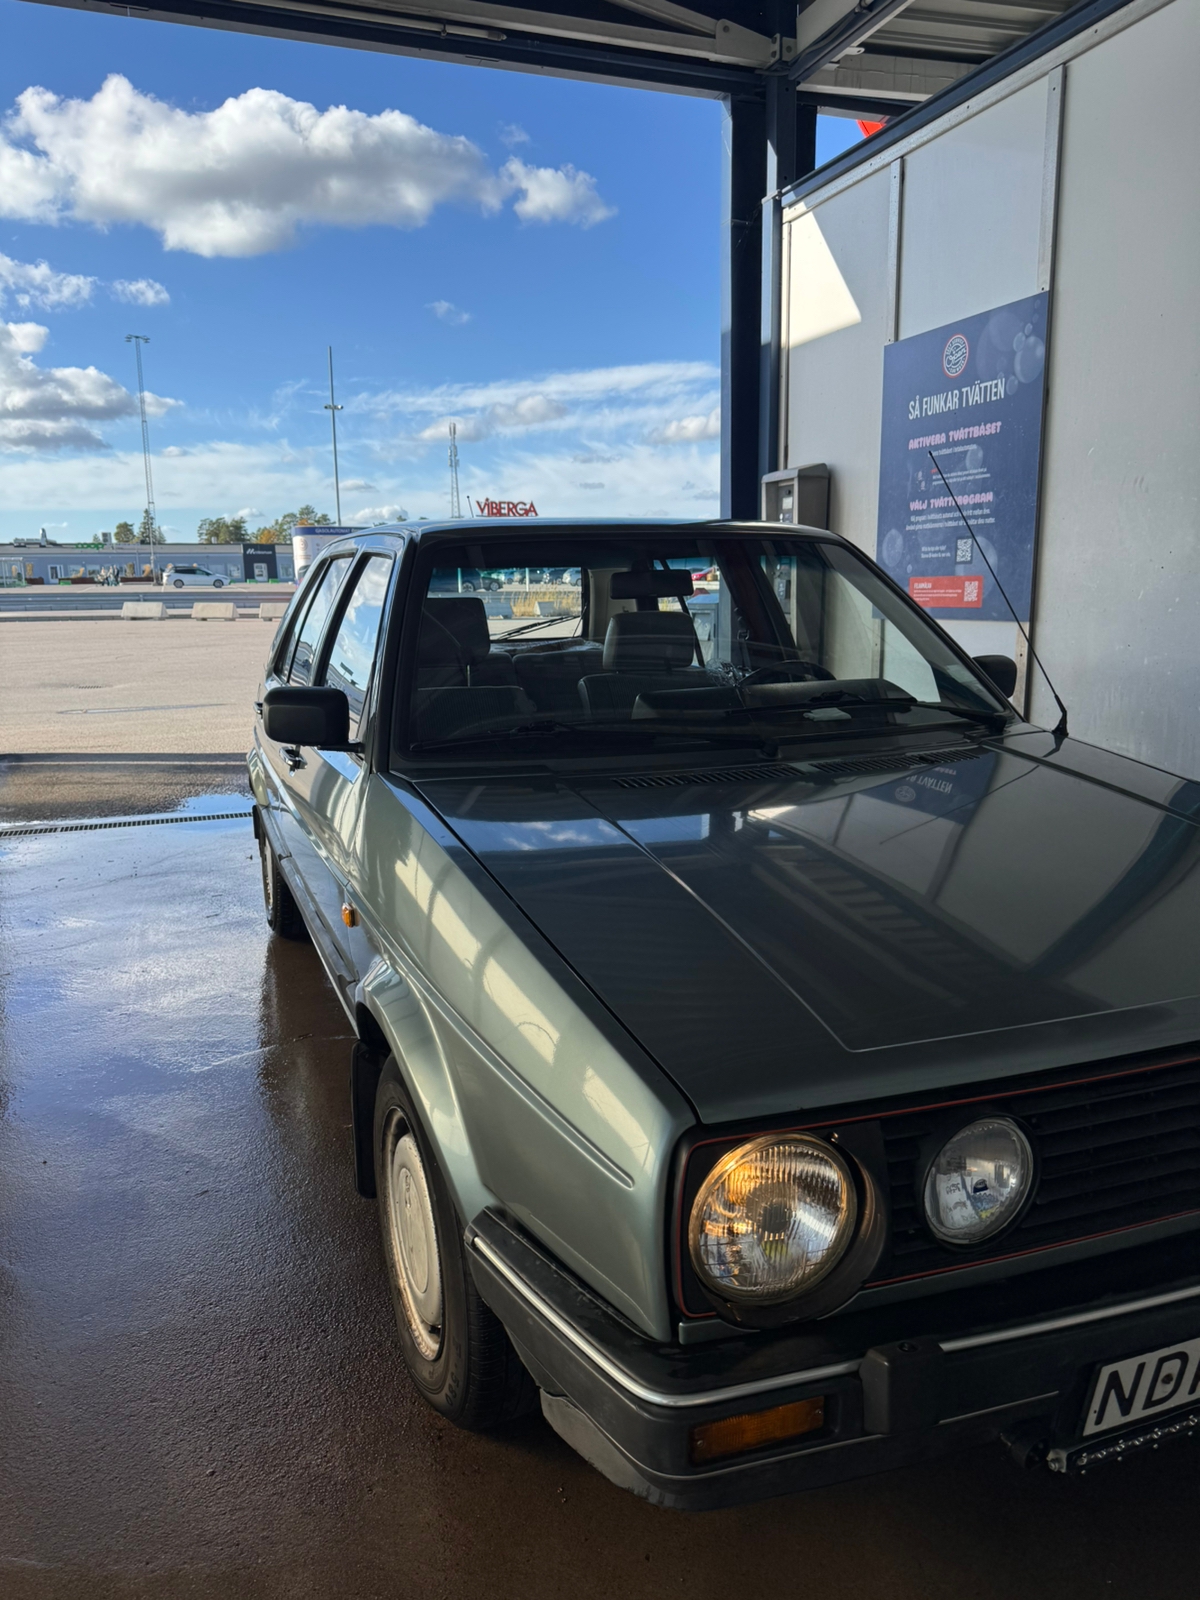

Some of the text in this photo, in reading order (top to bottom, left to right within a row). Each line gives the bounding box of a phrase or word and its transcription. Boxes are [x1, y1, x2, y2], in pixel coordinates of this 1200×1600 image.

[909, 378, 1005, 420] SÅ FUNKAR TVÄTTEN
[908, 421, 1002, 450] AKTIVERA TVÄTTBÅSET
[910, 499, 928, 511] VÄLJ
